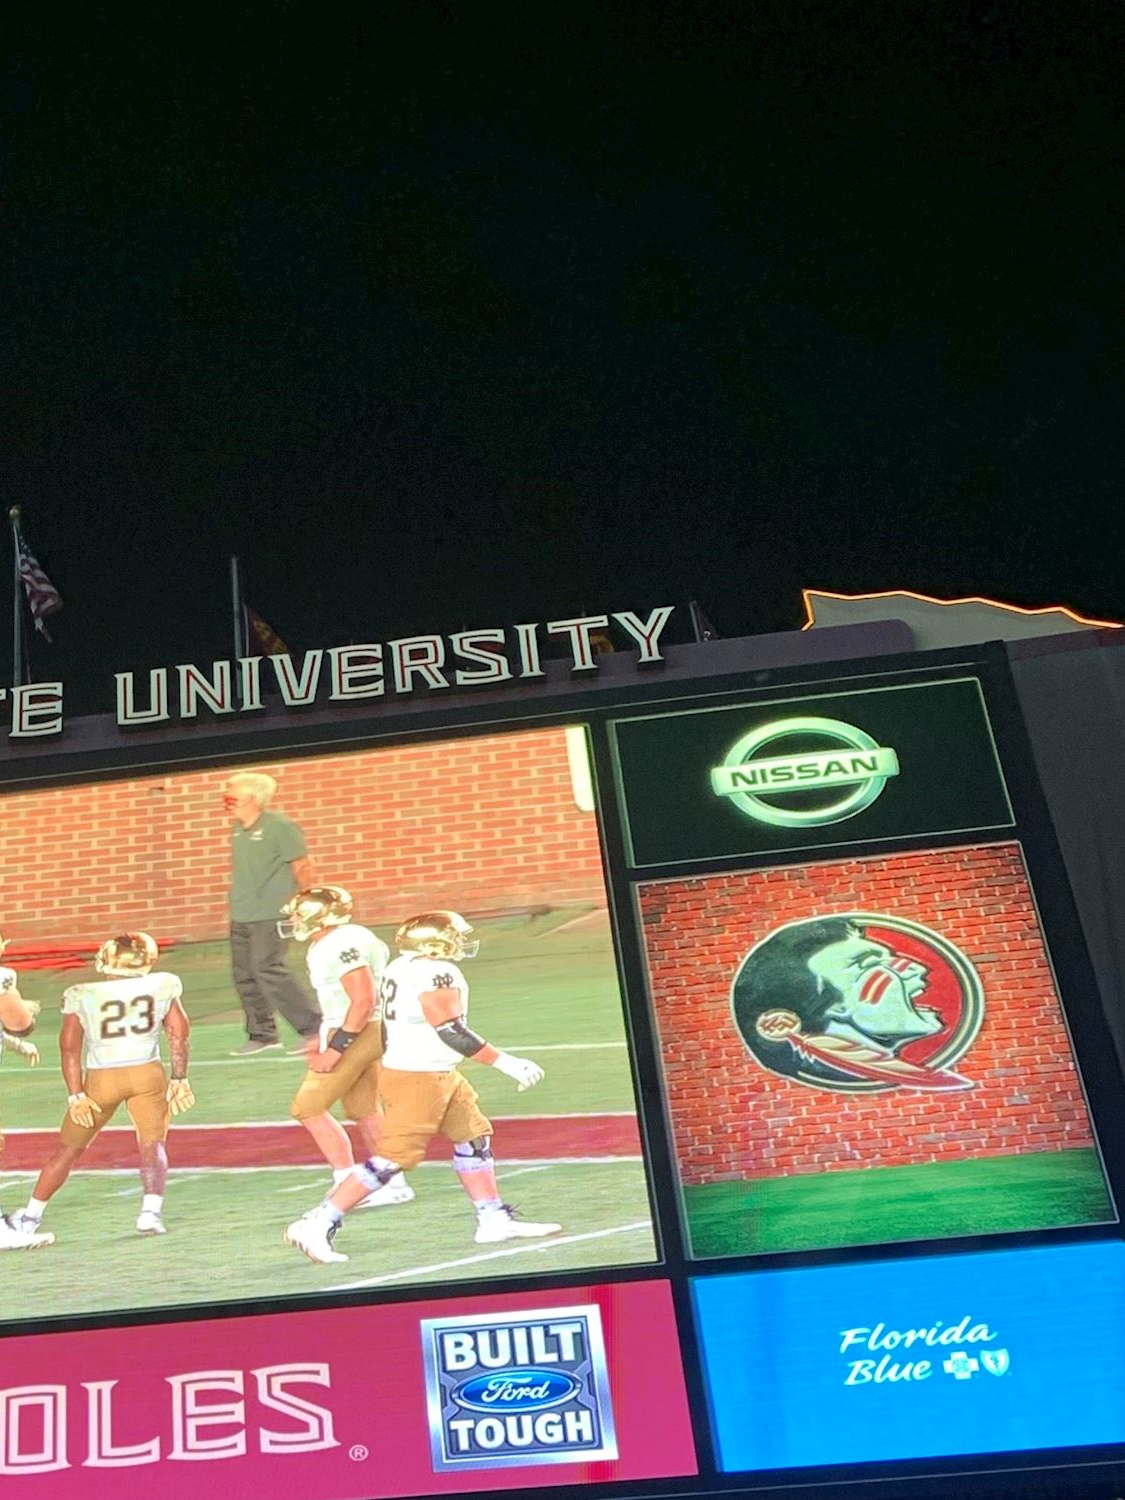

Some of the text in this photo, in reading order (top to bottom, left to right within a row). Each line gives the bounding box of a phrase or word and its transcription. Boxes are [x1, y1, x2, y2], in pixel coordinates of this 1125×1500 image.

[115, 606, 674, 727] UNIVERSITY
[729, 758, 879, 790] NISSAN
[101, 994, 155, 1039] 23
[380, 976, 397, 1021] 2
[441, 1323, 583, 1370] BUILT
[838, 1315, 997, 1353] Florida
[481, 1376, 550, 1404] Ford
[844, 1357, 933, 1386] Blue
[450, 1409, 594, 1451] TOUGH
